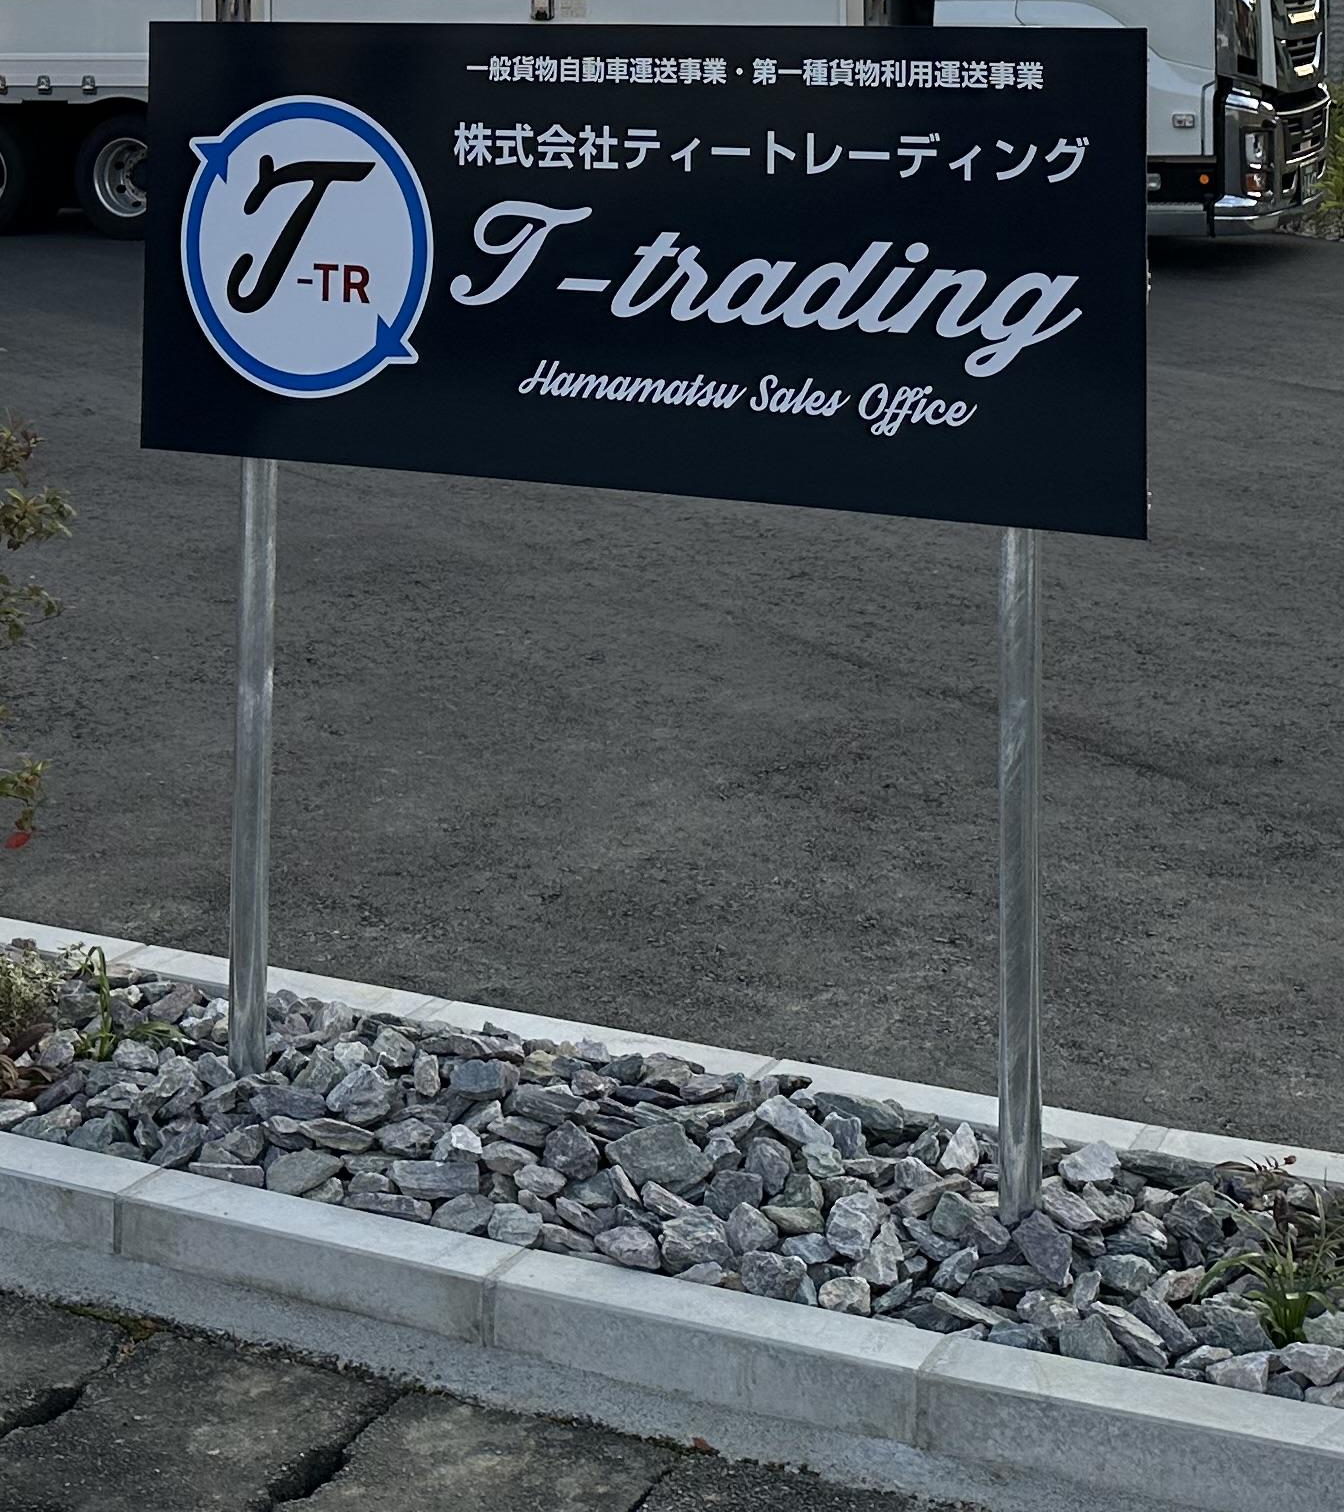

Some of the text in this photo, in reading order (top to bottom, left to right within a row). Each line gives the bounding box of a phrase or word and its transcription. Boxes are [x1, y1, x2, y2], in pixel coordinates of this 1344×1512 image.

[466, 55, 1044, 90] 一般貨物自動車運送事業・第一種貨物利用運送事業
[453, 121, 1090, 185] 株式会社ティートレーディング
[449, 200, 1083, 378] T-trading
[518, 359, 978, 437] Hamamatsu Sales Office
